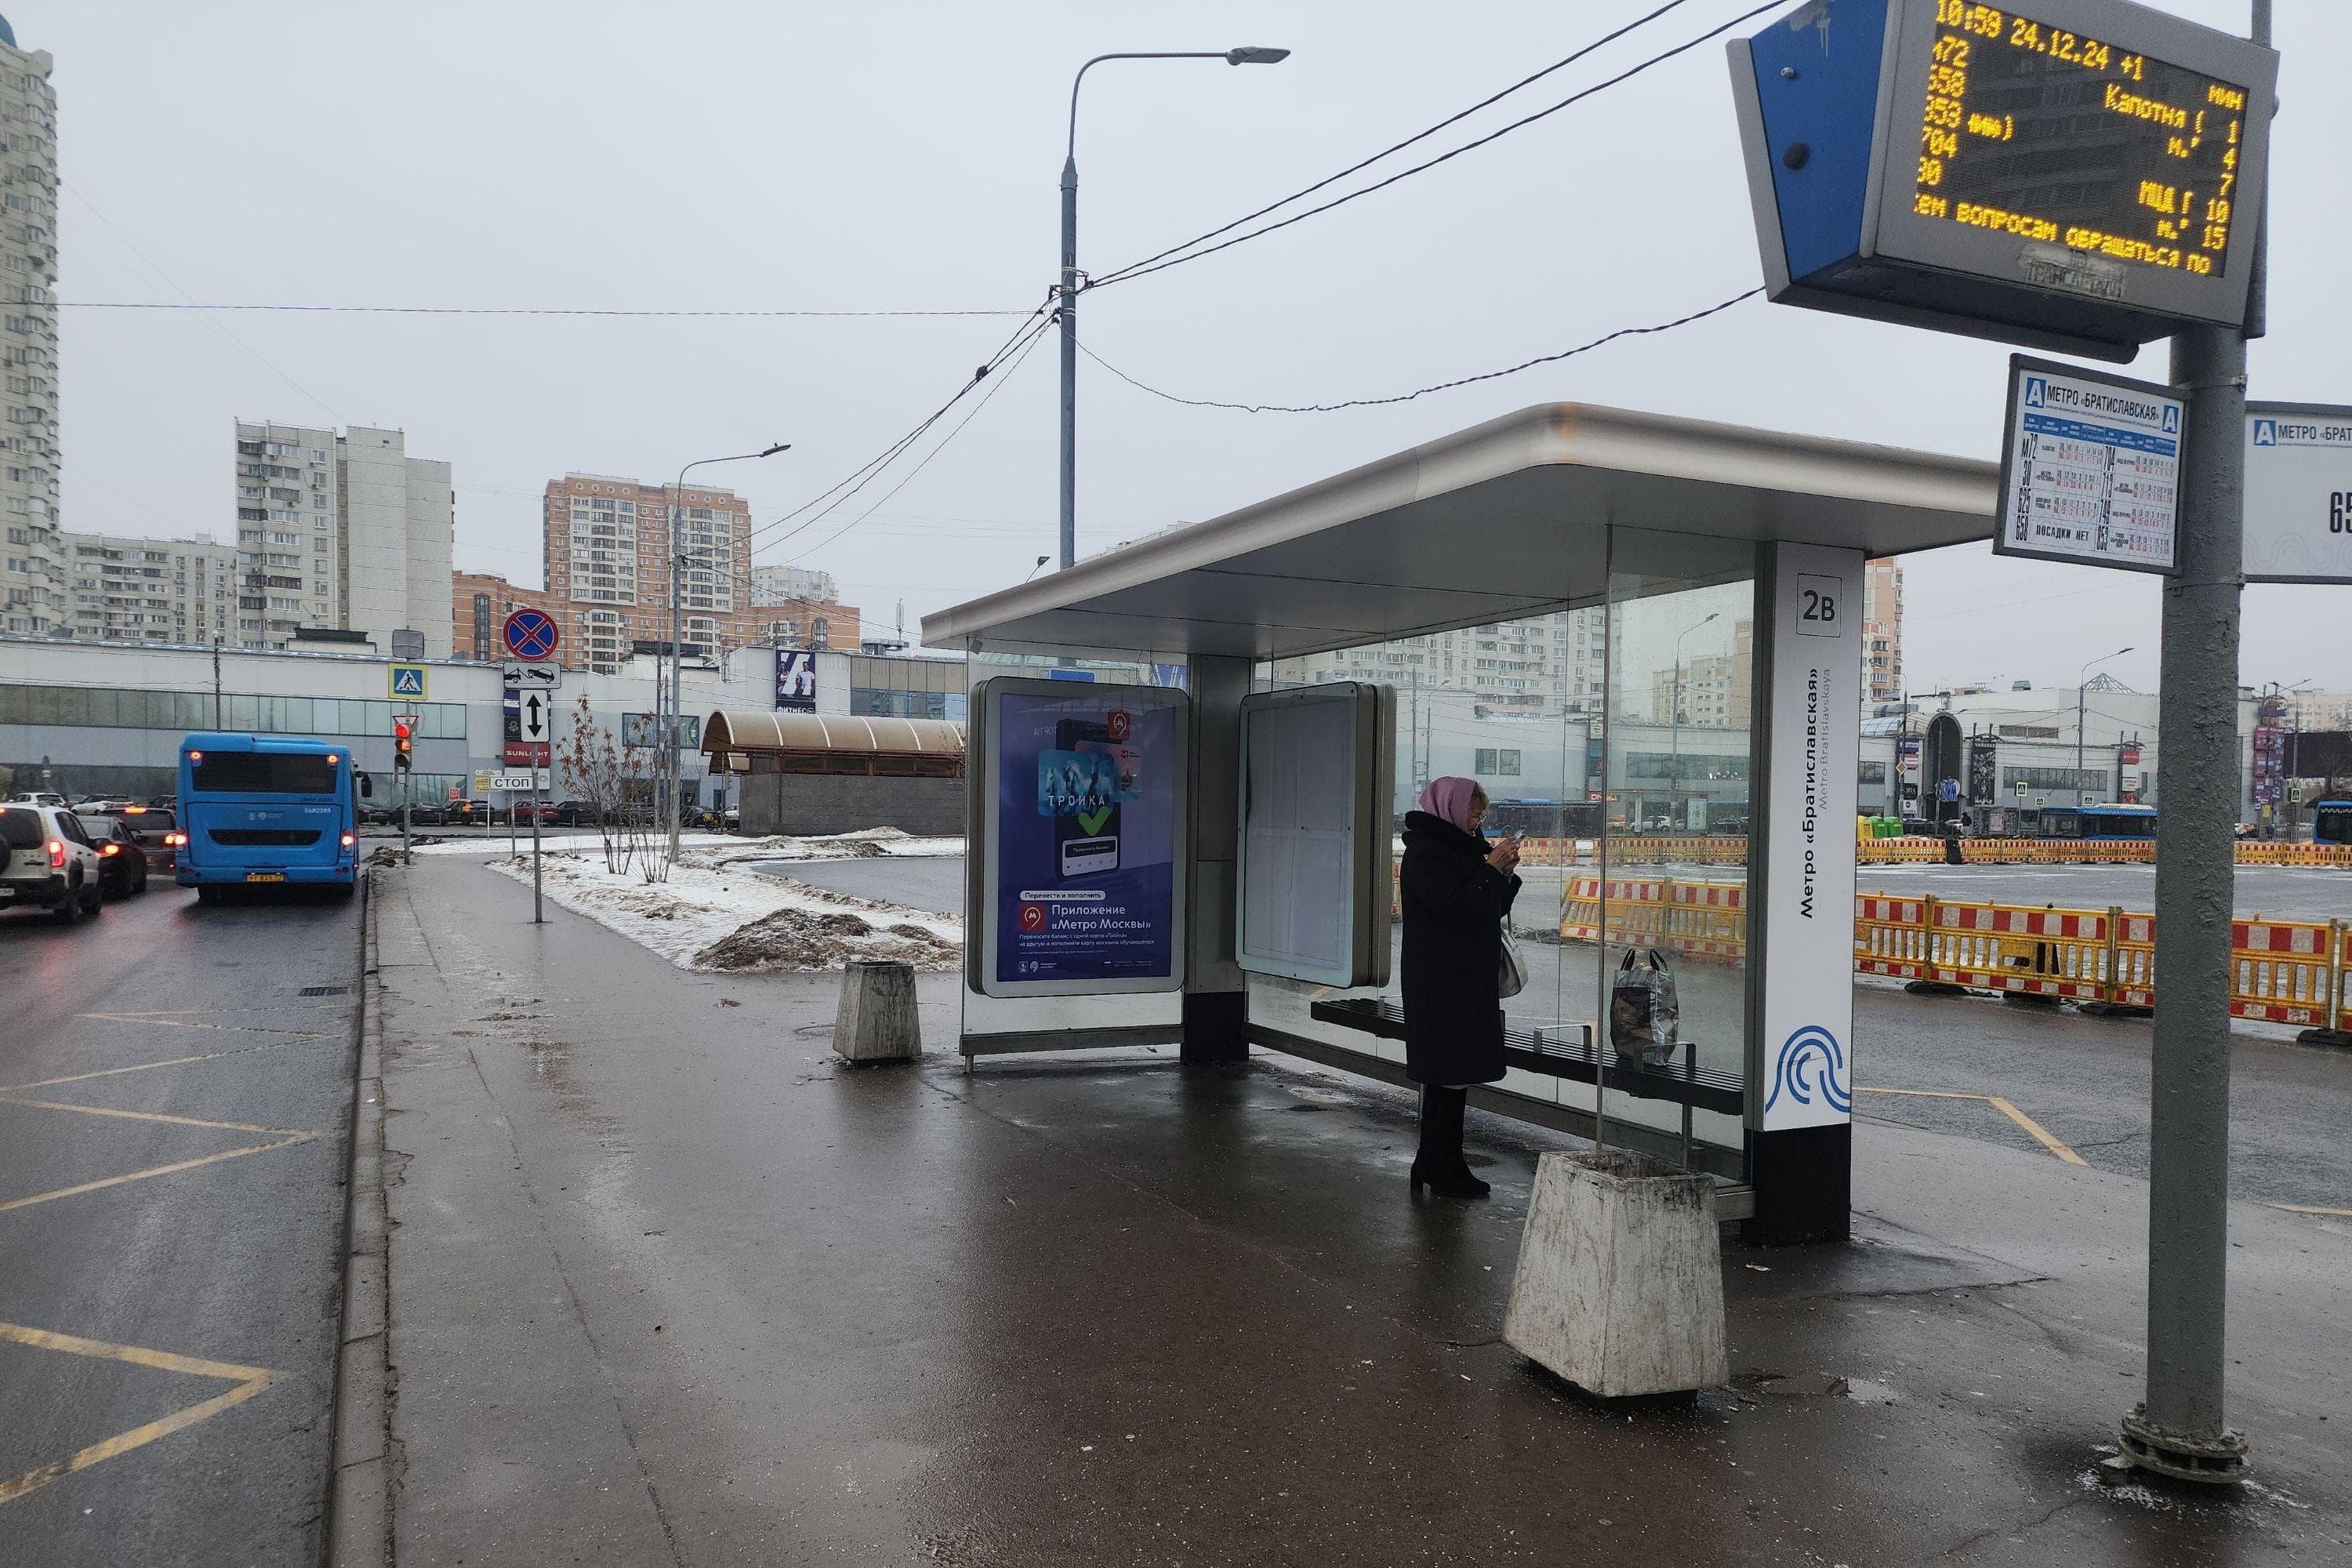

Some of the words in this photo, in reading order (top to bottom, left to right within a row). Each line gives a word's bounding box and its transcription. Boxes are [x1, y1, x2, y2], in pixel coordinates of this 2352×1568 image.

[2010, 17, 2111, 71] 24.12.24
[2121, 54, 2143, 82] +1
[2227, 120, 2239, 144] 1
[2223, 147, 2236, 170] 4
[2221, 172, 2234, 196] 7
[2206, 197, 2231, 223] 10
[2201, 224, 2227, 250] 15
[2046, 385, 2078, 406] МЕТРО
[2080, 392, 2160, 421] «БРАТИСЛАВСКАЯ»
[2278, 424, 2317, 440] МЕТРО
[2017, 488, 2031, 514] 625
[2099, 499, 2111, 525] 749
[2015, 515, 2029, 542] 658
[2035, 524, 2071, 540] ПОСАДКИ
[2075, 529, 2090, 542] НЕТ
[2096, 525, 2109, 551] 853
[1802, 590, 1835, 622] 2В
[1820, 668, 1832, 765] Bratislavskaya
[1802, 668, 1818, 845] «Братиславская»
[495, 778, 529, 788] СТОП
[1819, 768, 1828, 811] Metro
[1047, 792, 1106, 807] ТРОЙКА
[1800, 850, 1816, 920] Метро
[1051, 904, 1126, 917] Приложение
[1051, 919, 1097, 931] «Метро
[1099, 918, 1152, 929] Москвы»
